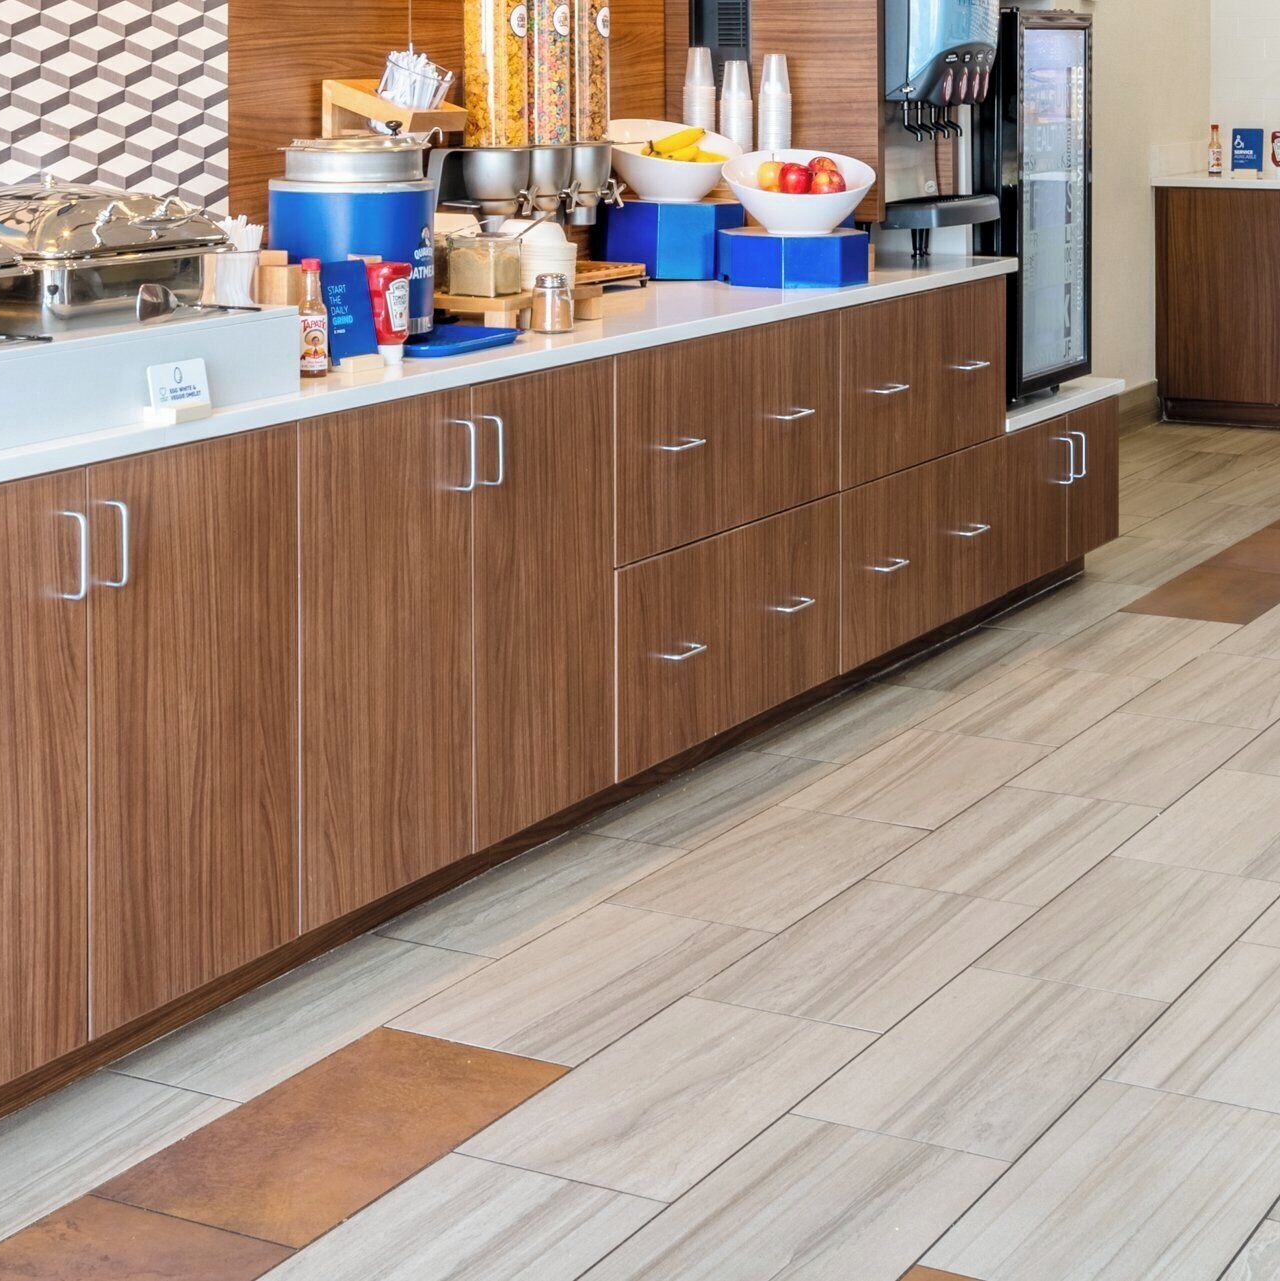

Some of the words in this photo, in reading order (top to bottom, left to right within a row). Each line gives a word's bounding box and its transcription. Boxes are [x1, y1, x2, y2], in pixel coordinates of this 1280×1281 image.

[327, 284, 346, 295] START
[329, 296, 342, 304] THE
[331, 306, 348, 316] DAILY
[333, 315, 353, 325] GRIND
